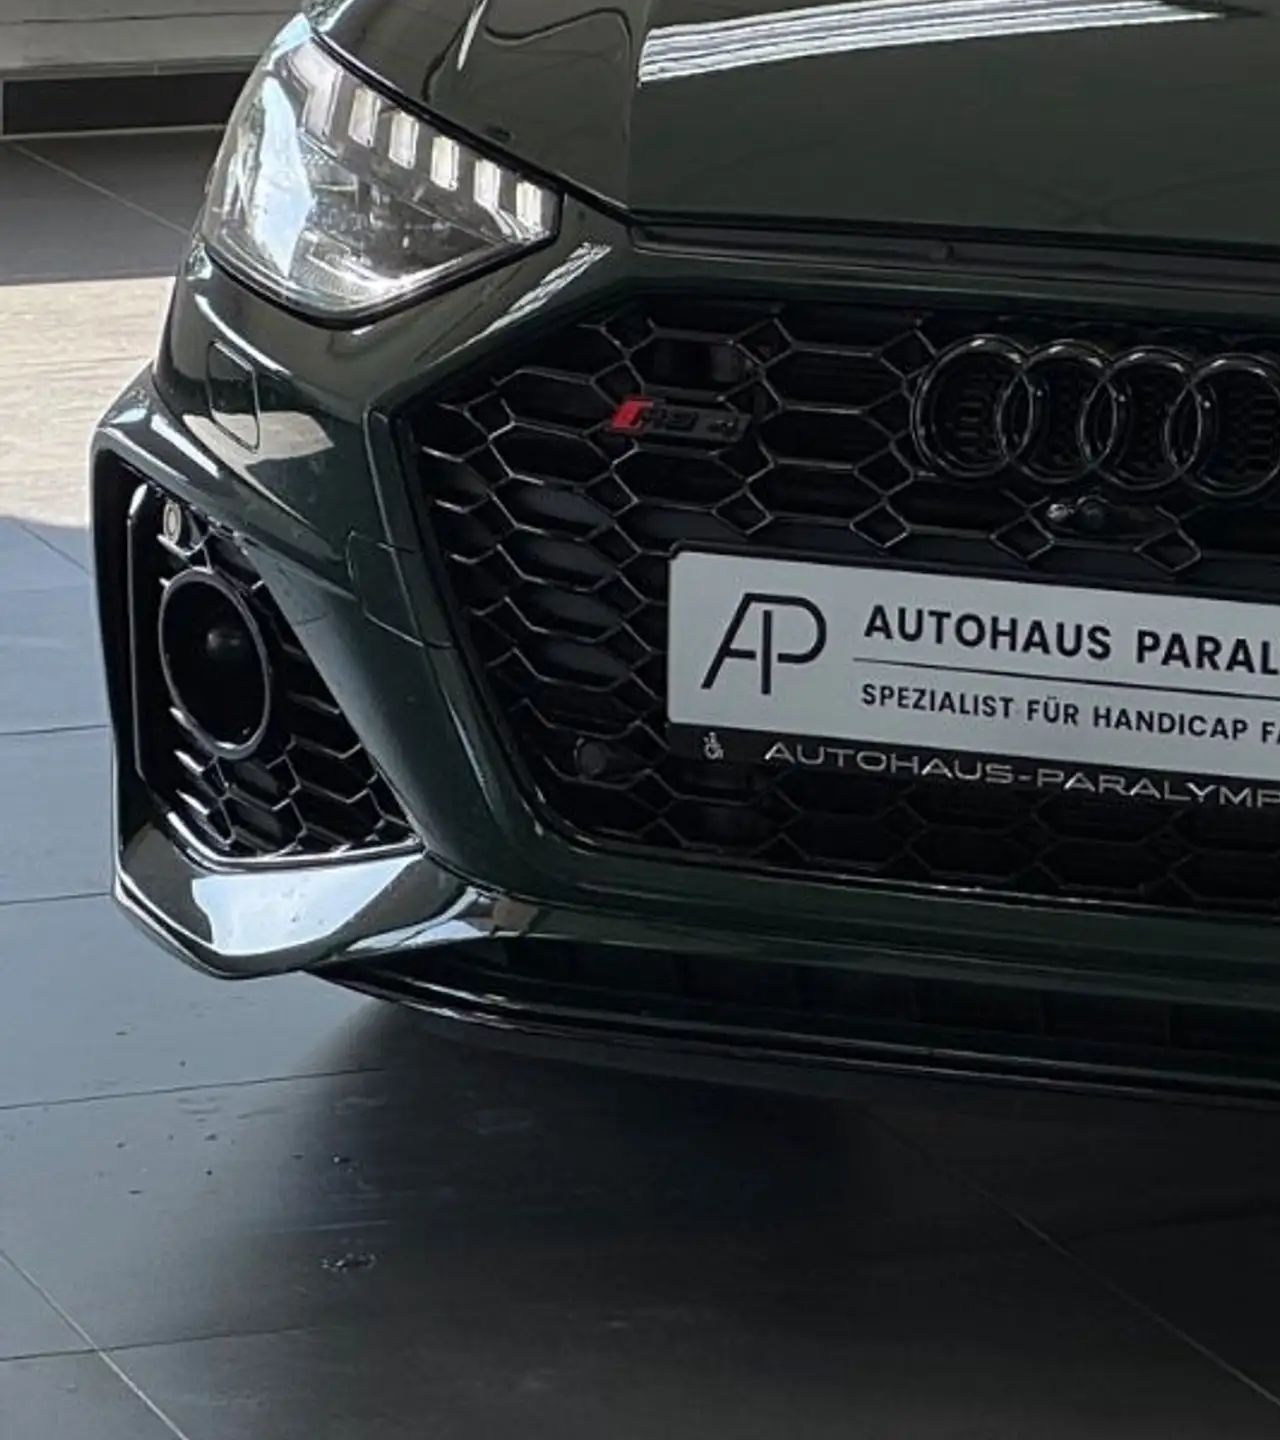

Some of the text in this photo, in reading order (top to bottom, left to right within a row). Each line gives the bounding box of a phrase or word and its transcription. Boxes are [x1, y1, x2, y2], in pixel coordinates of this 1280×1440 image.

[701, 593, 828, 695] AP
[864, 604, 1112, 659] AUTOHAUS
[861, 683, 1014, 720] SPEZIALIST
[1027, 696, 1079, 726] FÜR
[1092, 706, 1248, 741] HANDICAP
